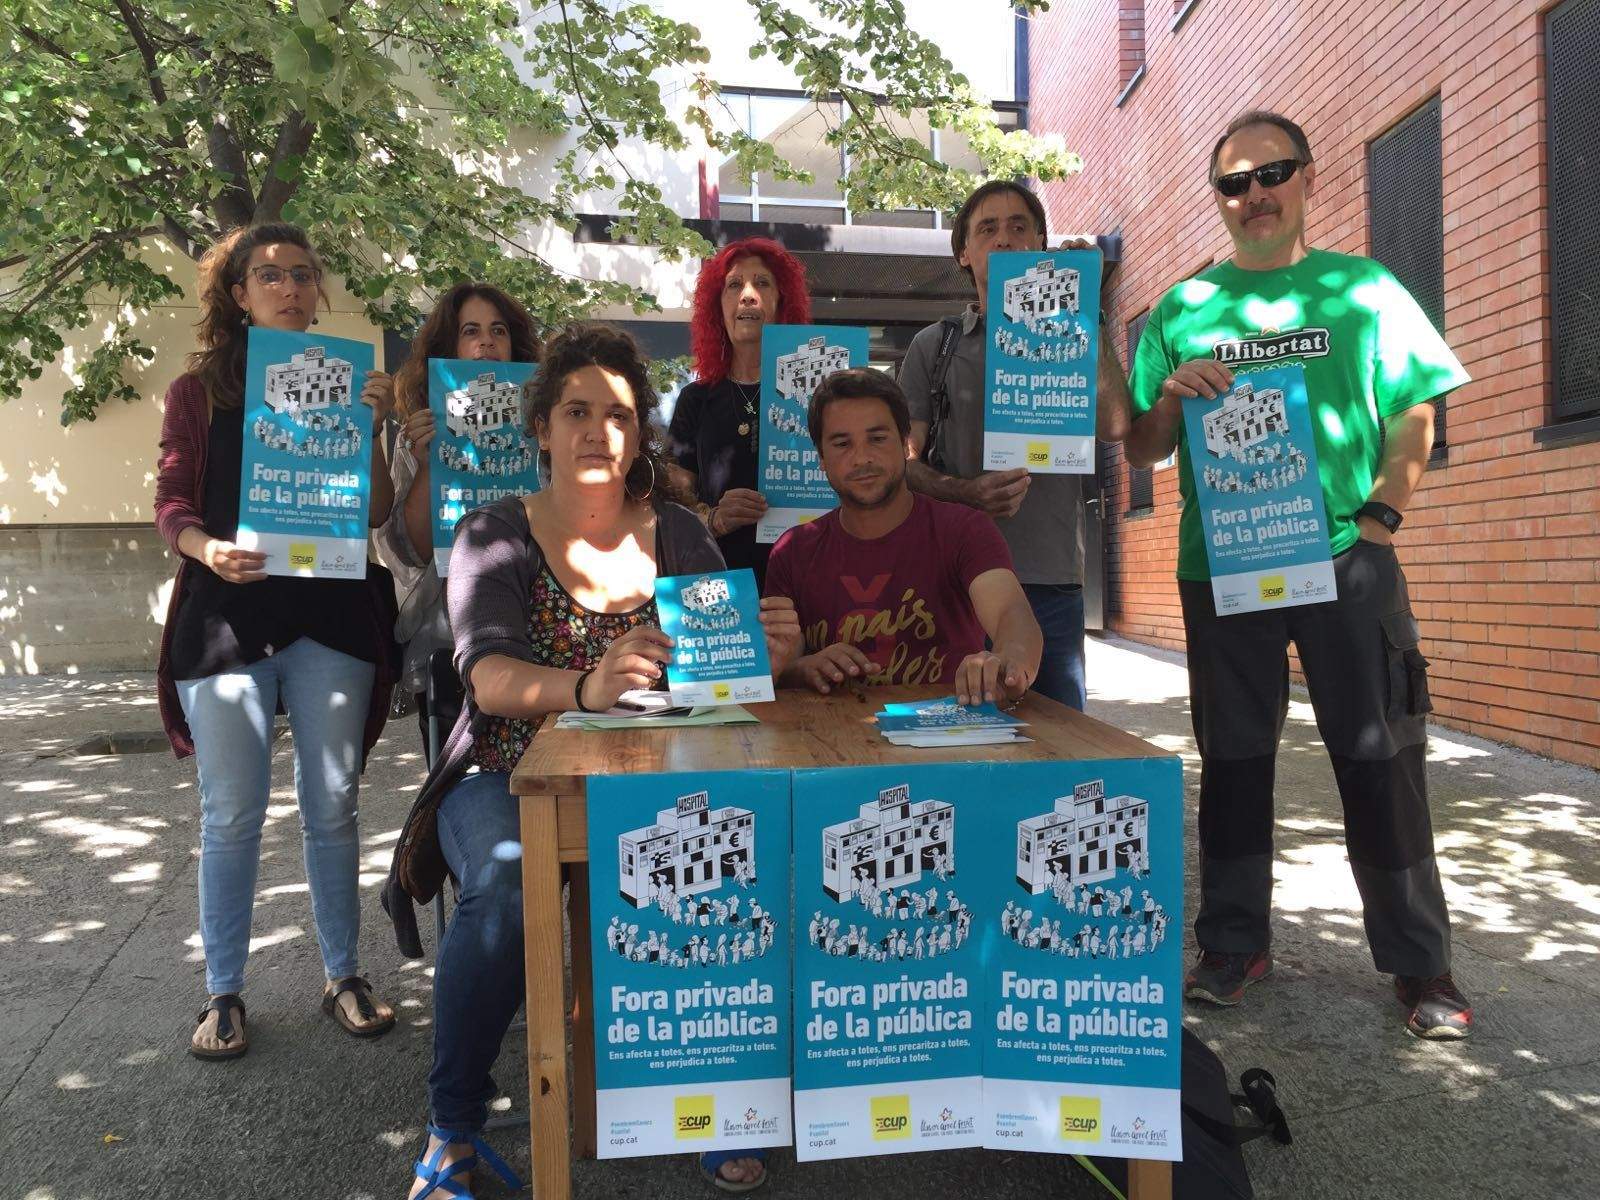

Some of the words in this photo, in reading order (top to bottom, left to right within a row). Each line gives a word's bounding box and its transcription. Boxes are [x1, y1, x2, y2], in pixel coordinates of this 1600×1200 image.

[1221, 335, 1322, 361] Llibertat
[996, 370, 1026, 386] Fora
[1031, 372, 1086, 390] privada
[992, 389, 1010, 404] de
[1015, 390, 1028, 405] la
[1032, 390, 1088, 410] pública
[768, 446, 798, 461] Fora
[254, 463, 290, 482] Fora
[295, 468, 359, 488] privada
[766, 465, 782, 480] de
[787, 465, 800, 480] la
[249, 484, 271, 502] de
[276, 486, 292, 503] la
[297, 488, 360, 508] pública
[441, 484, 473, 500] Fora
[1212, 509, 1247, 526] Fora
[1251, 496, 1313, 524] privada
[1213, 530, 1232, 546] de
[1236, 526, 1252, 542] la
[1257, 517, 1319, 544] pública
[677, 636, 704, 648] Fora
[707, 631, 751, 649] privada
[677, 651, 692, 664] de
[695, 650, 707, 662] la
[711, 646, 755, 664] pública
[880, 786, 909, 806] HOSPITAL
[1075, 782, 1103, 799] HOSPITAL
[678, 793, 708, 811] HOSPITAL
[611, 985, 668, 1012] Fora
[675, 978, 773, 1015] privada
[811, 981, 866, 1008] Fora
[873, 972, 967, 1010] privada
[1002, 971, 1057, 1000] Fora
[1065, 974, 1163, 1007] privada
[608, 1018, 640, 1043] de
[648, 1016, 672, 1041] la
[681, 1011, 777, 1045] pública
[807, 1014, 837, 1041] de
[846, 1012, 869, 1038] la
[877, 1005, 971, 1042] pública
[997, 1004, 1028, 1032] de
[1037, 1006, 1061, 1033] la
[1069, 1007, 1168, 1040] pública
[626, 1049, 651, 1058] afecta
[703, 1044, 745, 1055] precaritza
[808, 1050, 821, 1058] Ens
[824, 1048, 849, 1057] afecta
[899, 1040, 938, 1052] precaritza
[997, 1039, 1011, 1048] Ens
[1014, 1040, 1039, 1049] afecta
[1091, 1045, 1133, 1054] precaritza
[666, 1057, 704, 1069] perjudica
[863, 1054, 900, 1068] perjudica
[1053, 1055, 1092, 1066] perjudica
[687, 1114, 711, 1129] cup
[883, 1115, 907, 1130] cup
[1073, 1117, 1097, 1132] cup
[610, 1137, 638, 1146] cup.cat
[810, 1139, 836, 1147] cup.cat
